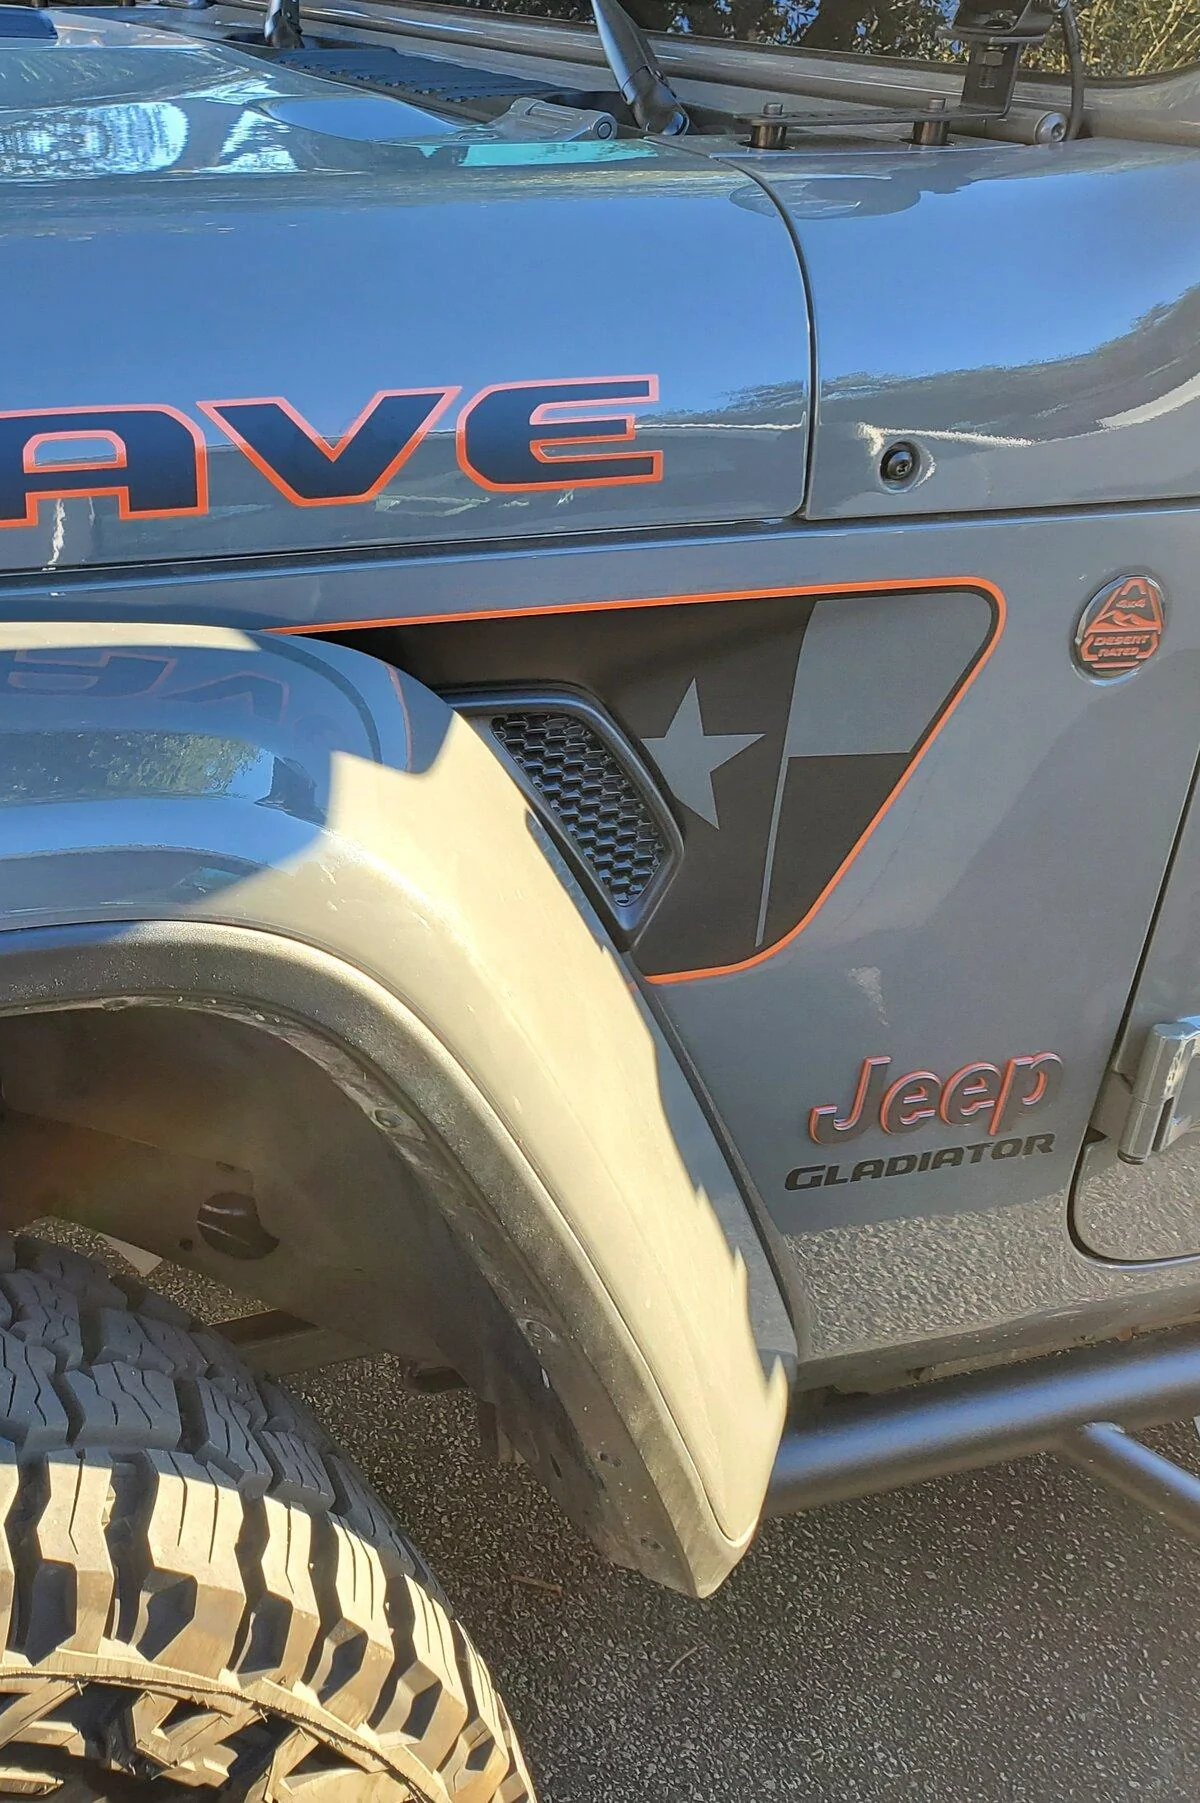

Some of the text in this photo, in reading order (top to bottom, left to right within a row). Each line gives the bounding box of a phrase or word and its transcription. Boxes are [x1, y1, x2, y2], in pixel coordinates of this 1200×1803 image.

[1097, 647, 1140, 657] RATED
[807, 1051, 1063, 1145] Jeep
[784, 1133, 1056, 1191] GLADIATOR
